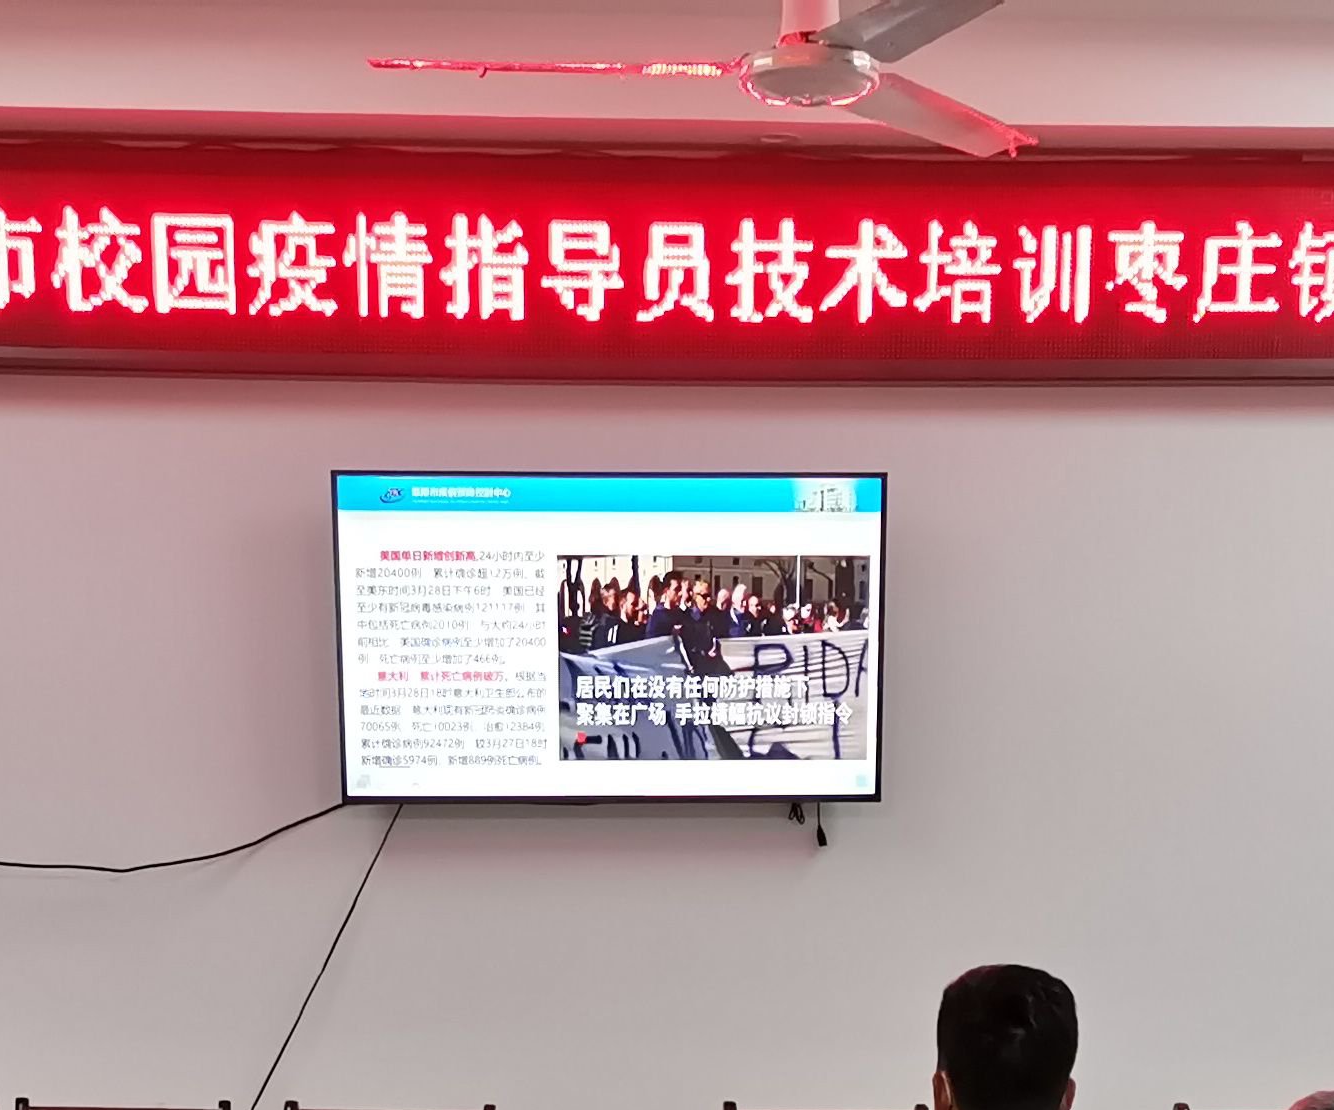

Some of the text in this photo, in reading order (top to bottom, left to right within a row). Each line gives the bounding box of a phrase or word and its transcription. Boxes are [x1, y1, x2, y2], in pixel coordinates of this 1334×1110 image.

[575, 675, 810, 700] 居民们在没有任何防护措施下
[575, 702, 854, 726] 聚集在广场 手拉横幅抗议封锁指令
